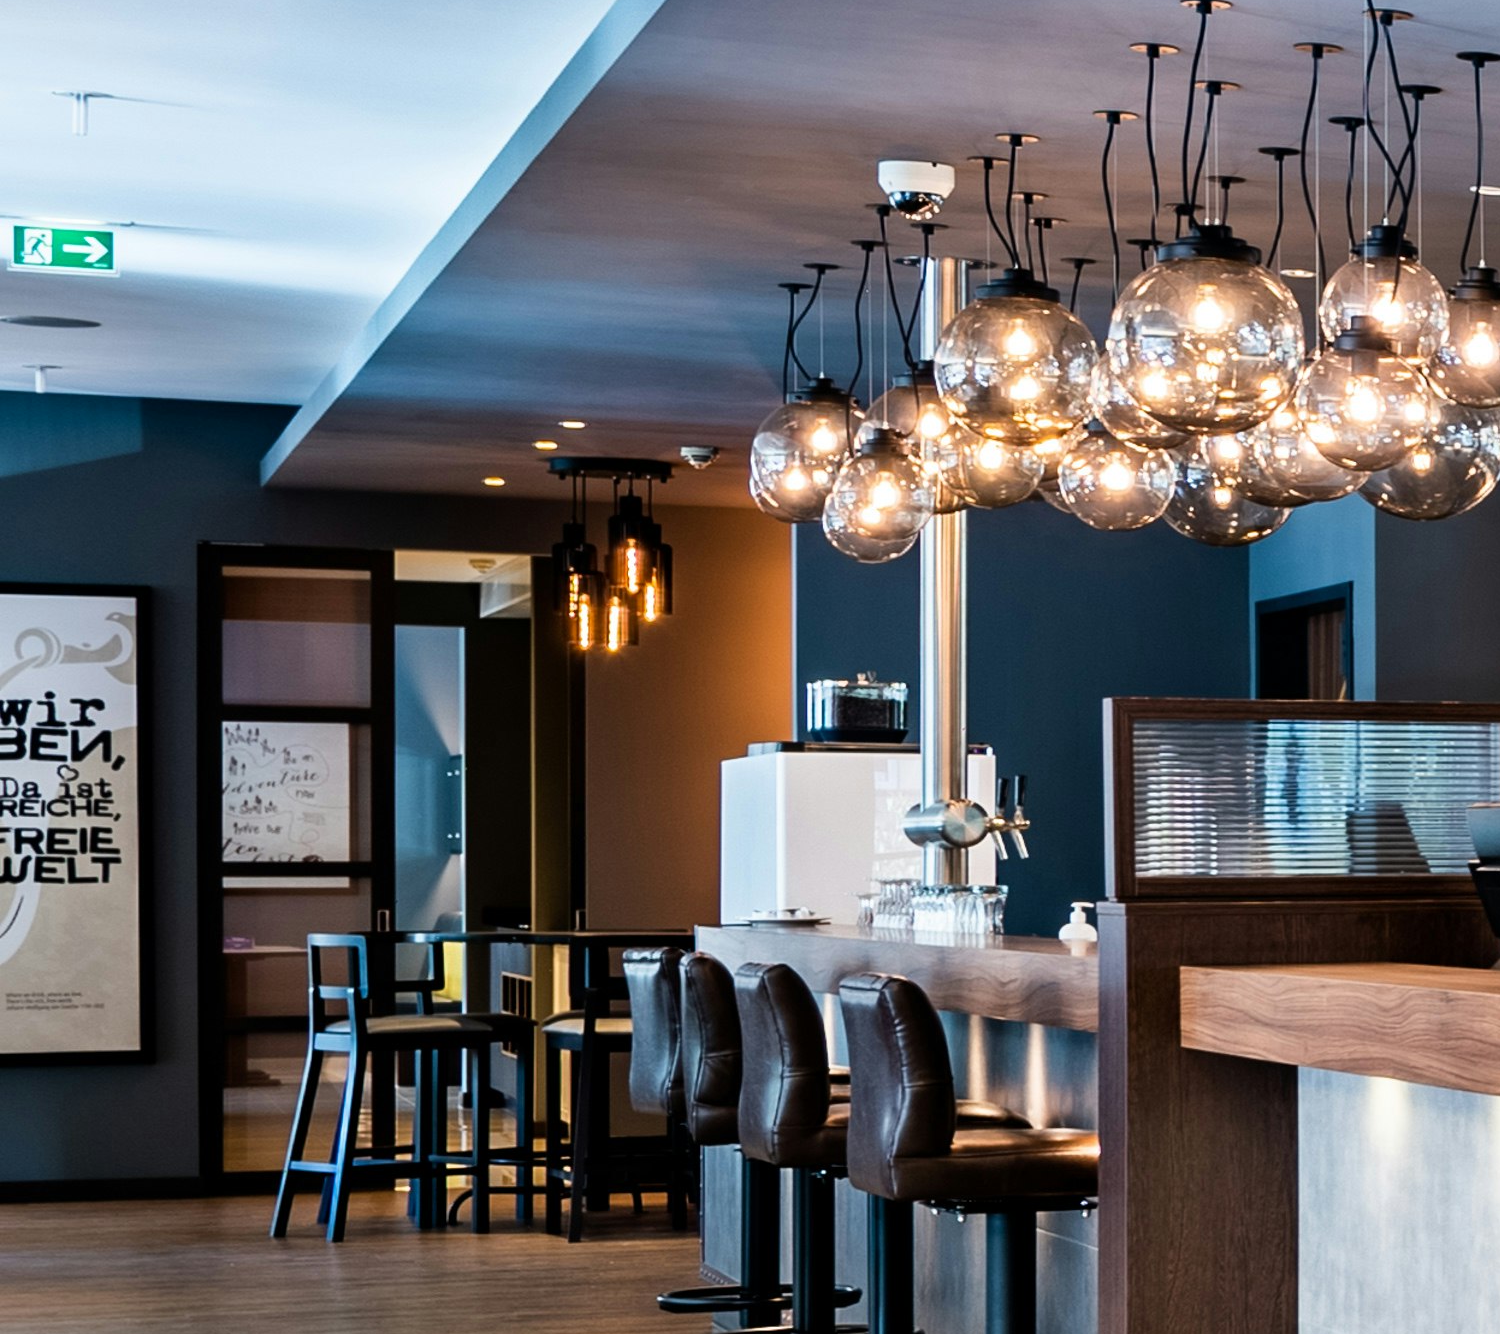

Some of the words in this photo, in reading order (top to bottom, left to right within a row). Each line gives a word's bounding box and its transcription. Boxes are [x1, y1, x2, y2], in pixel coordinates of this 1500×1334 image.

[0, 691, 105, 727] wir
[0, 777, 41, 799] Da
[57, 764, 113, 799] ist
